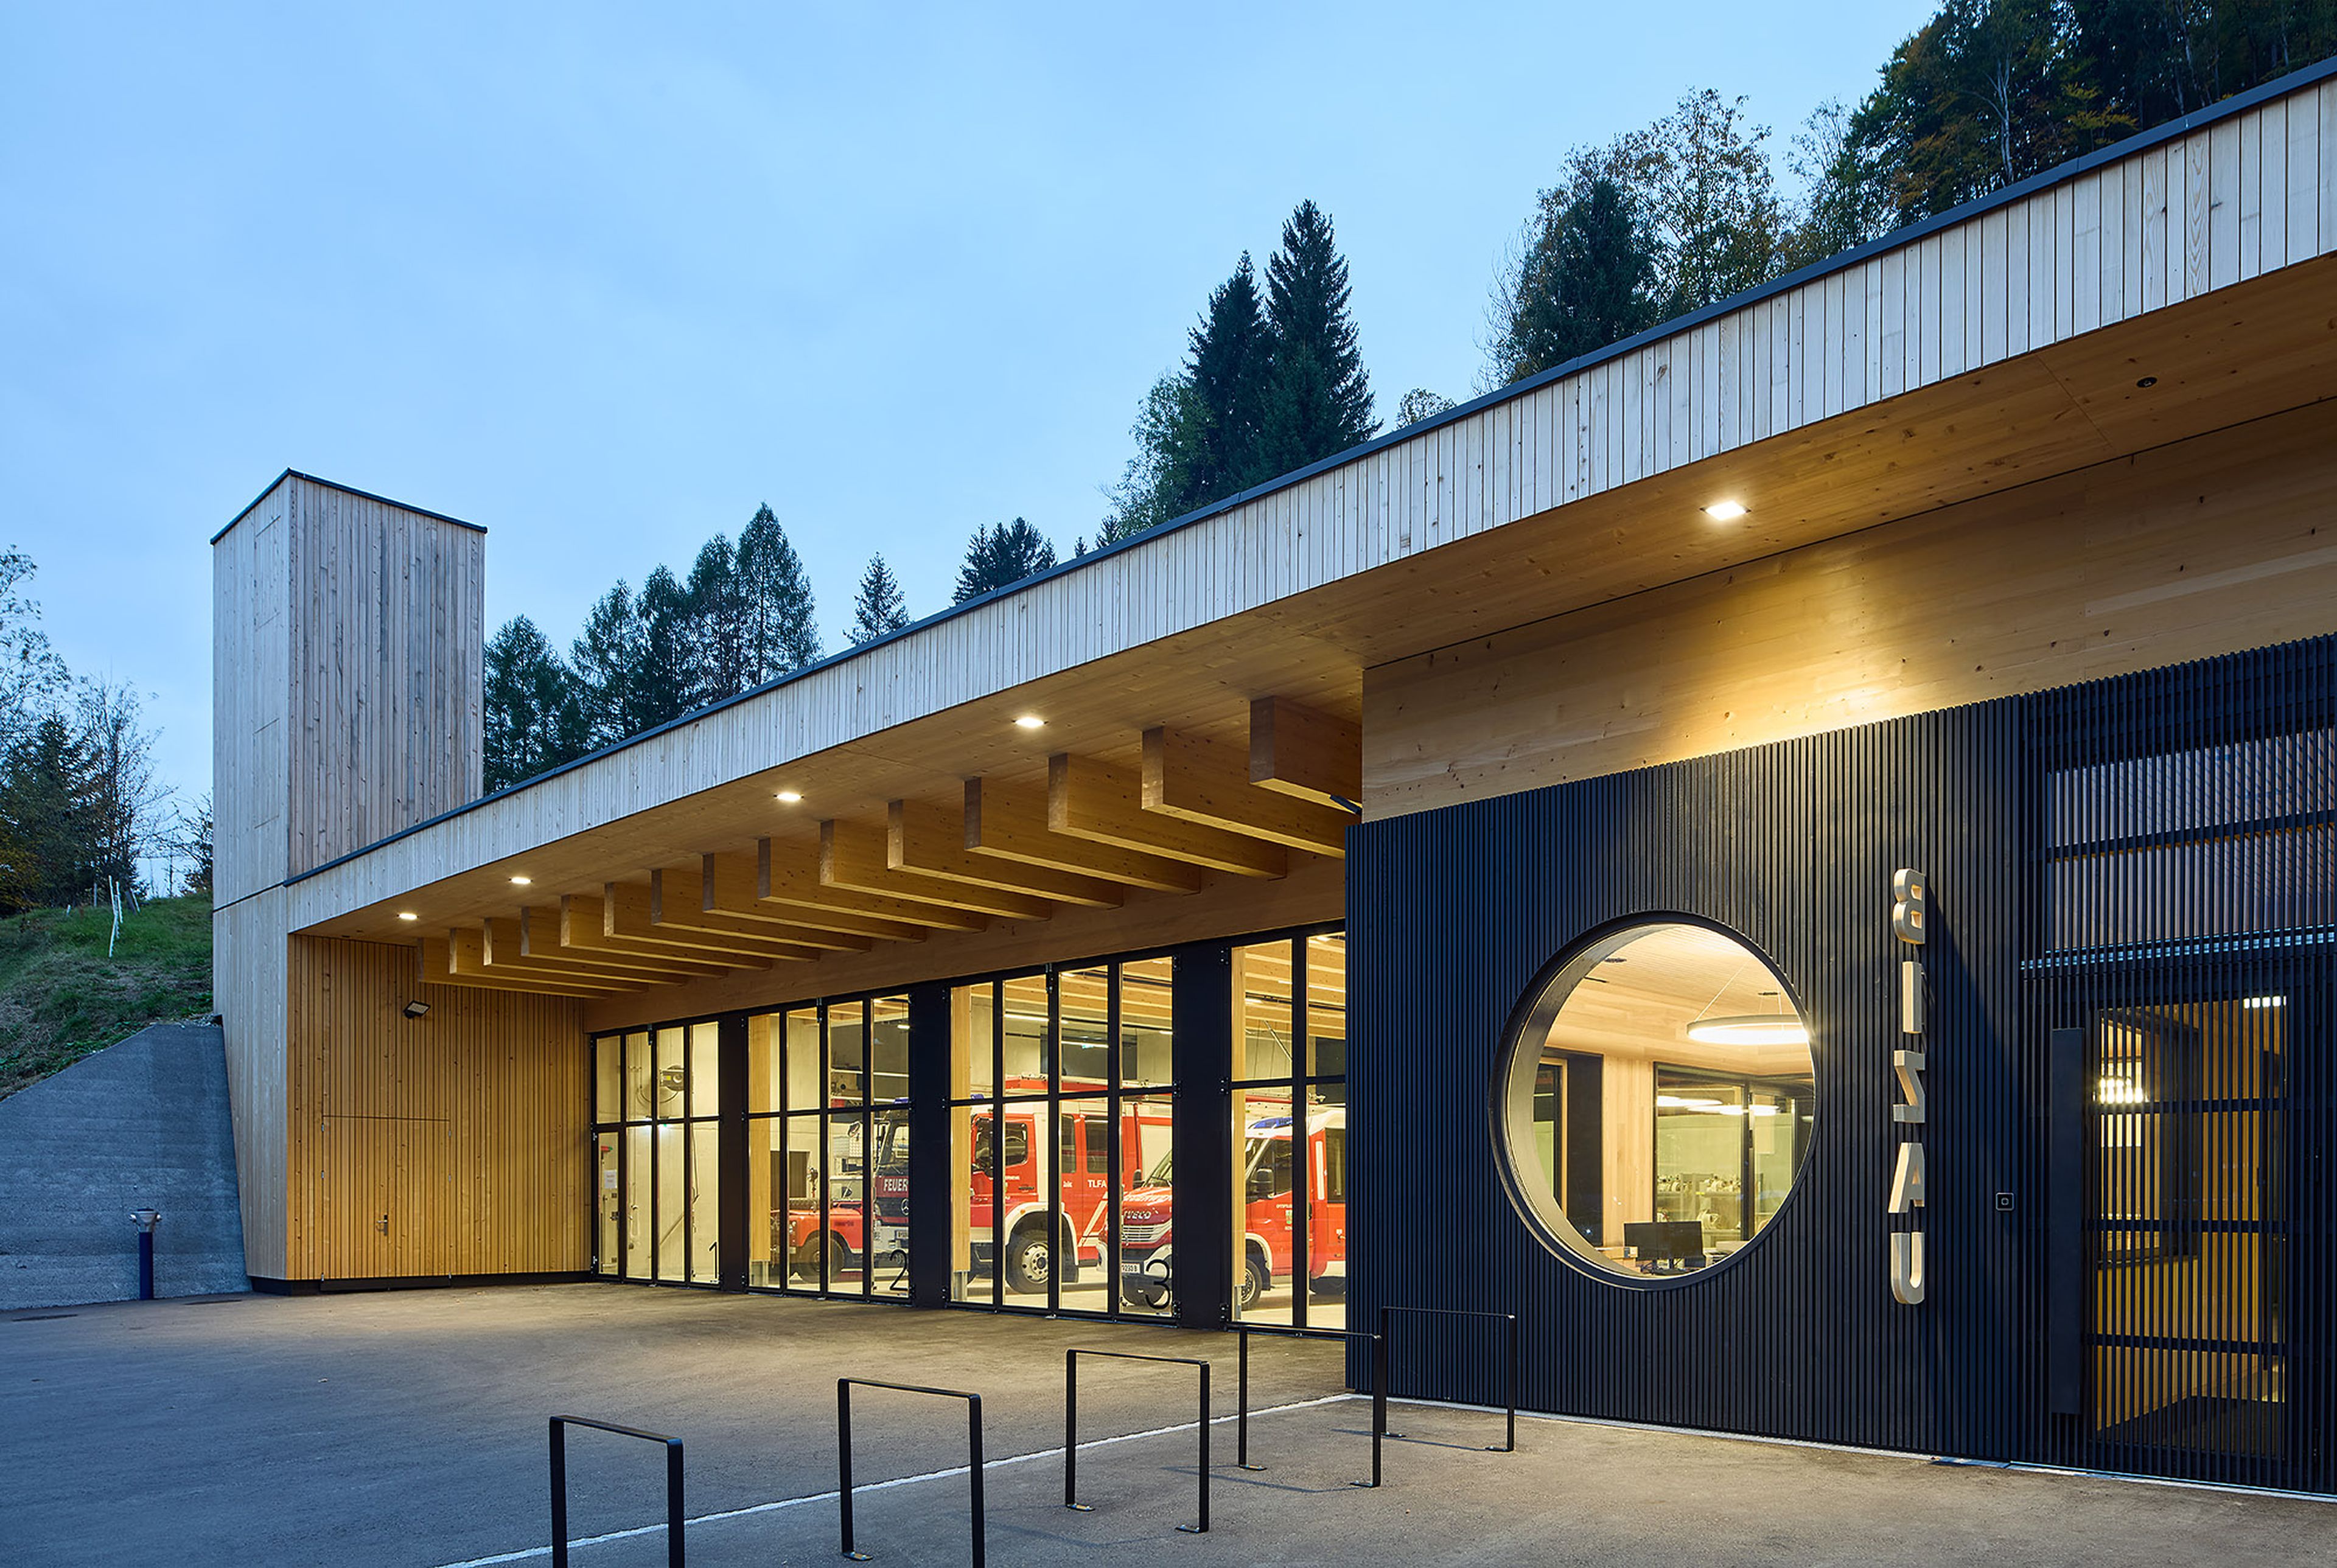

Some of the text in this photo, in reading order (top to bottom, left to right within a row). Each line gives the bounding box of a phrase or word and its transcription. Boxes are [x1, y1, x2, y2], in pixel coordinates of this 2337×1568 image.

[1124, 1210, 1152, 1219] IVECO
[709, 1242, 717, 1279] 1
[890, 1249, 908, 1291] 2
[1145, 1259, 1170, 1308] 3
